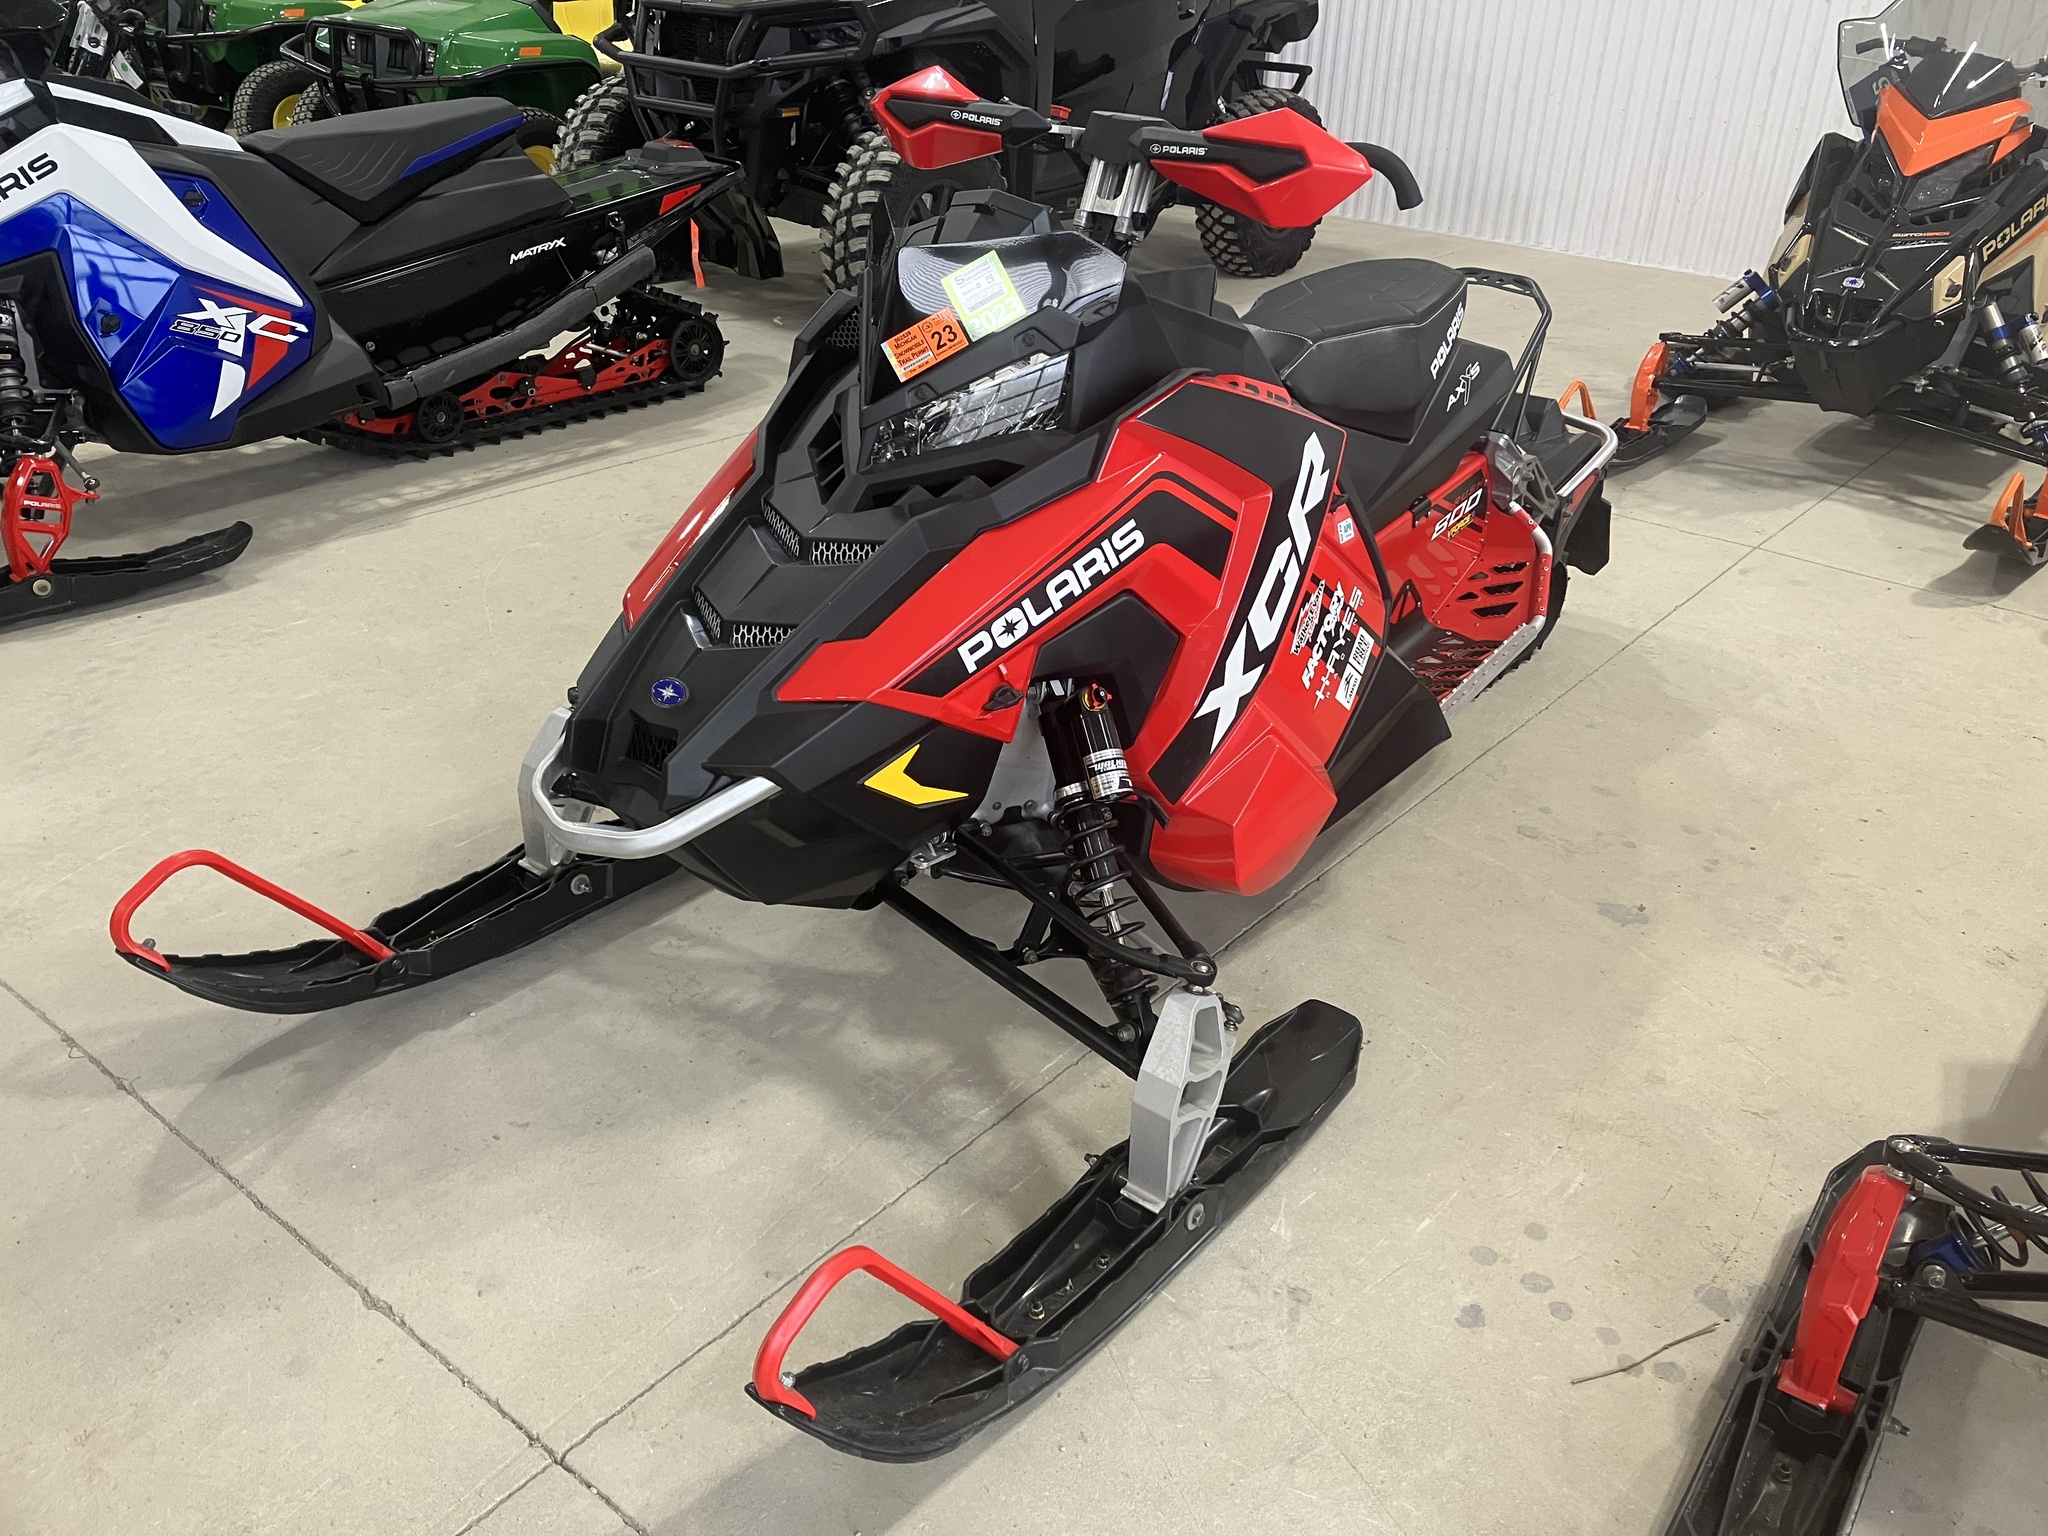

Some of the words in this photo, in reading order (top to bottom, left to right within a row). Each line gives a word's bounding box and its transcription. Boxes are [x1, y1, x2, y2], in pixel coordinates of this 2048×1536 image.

[962, 112, 1001, 126] POLARIS
[1162, 146, 1206, 155] POLARIS
[0, 152, 58, 201] RIS
[510, 236, 566, 265] MATRYX
[1982, 193, 2048, 262] POLARI
[169, 319, 241, 343] 850
[177, 297, 309, 343] XC
[931, 325, 958, 350] 23
[968, 296, 1022, 335] 2023
[1430, 301, 1464, 380] POLARIS
[24, 500, 61, 508] POLARIS
[957, 518, 1145, 674] POLARIS
[1193, 431, 1330, 754] XCR
[1301, 580, 1345, 690] FACTORY
[1313, 586, 1362, 710] HAYES
